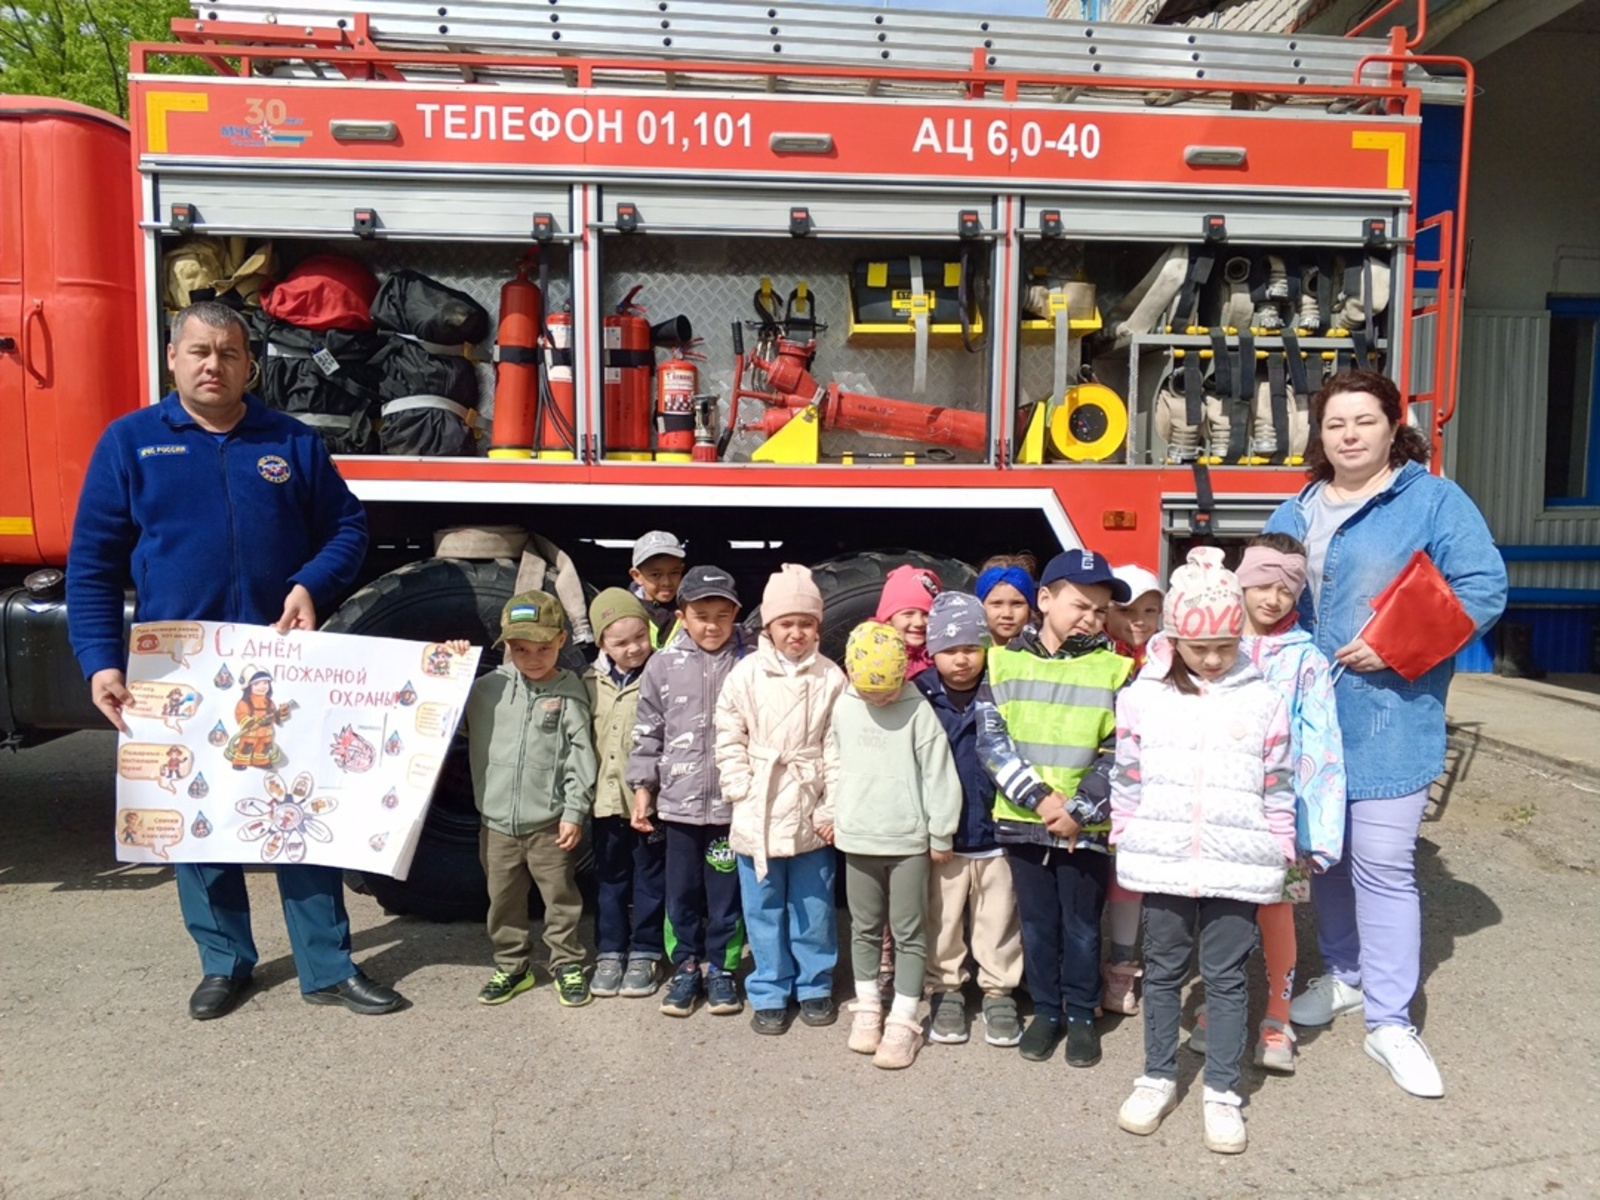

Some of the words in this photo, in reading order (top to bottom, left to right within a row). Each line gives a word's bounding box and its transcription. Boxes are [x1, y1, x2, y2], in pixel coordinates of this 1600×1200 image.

[244, 98, 286, 125] 30
[221, 125, 253, 138] МЧС
[415, 103, 623, 145] ТЕЛЕФОН
[637, 109, 752, 152] 01,101
[912, 117, 974, 161] АЦ
[987, 119, 1100, 163] 6,0-40
[240, 638, 302, 661] ДНЁМ
[273, 664, 368, 685] ПОЖАРНОЙ
[670, 762, 697, 776] NIKE
